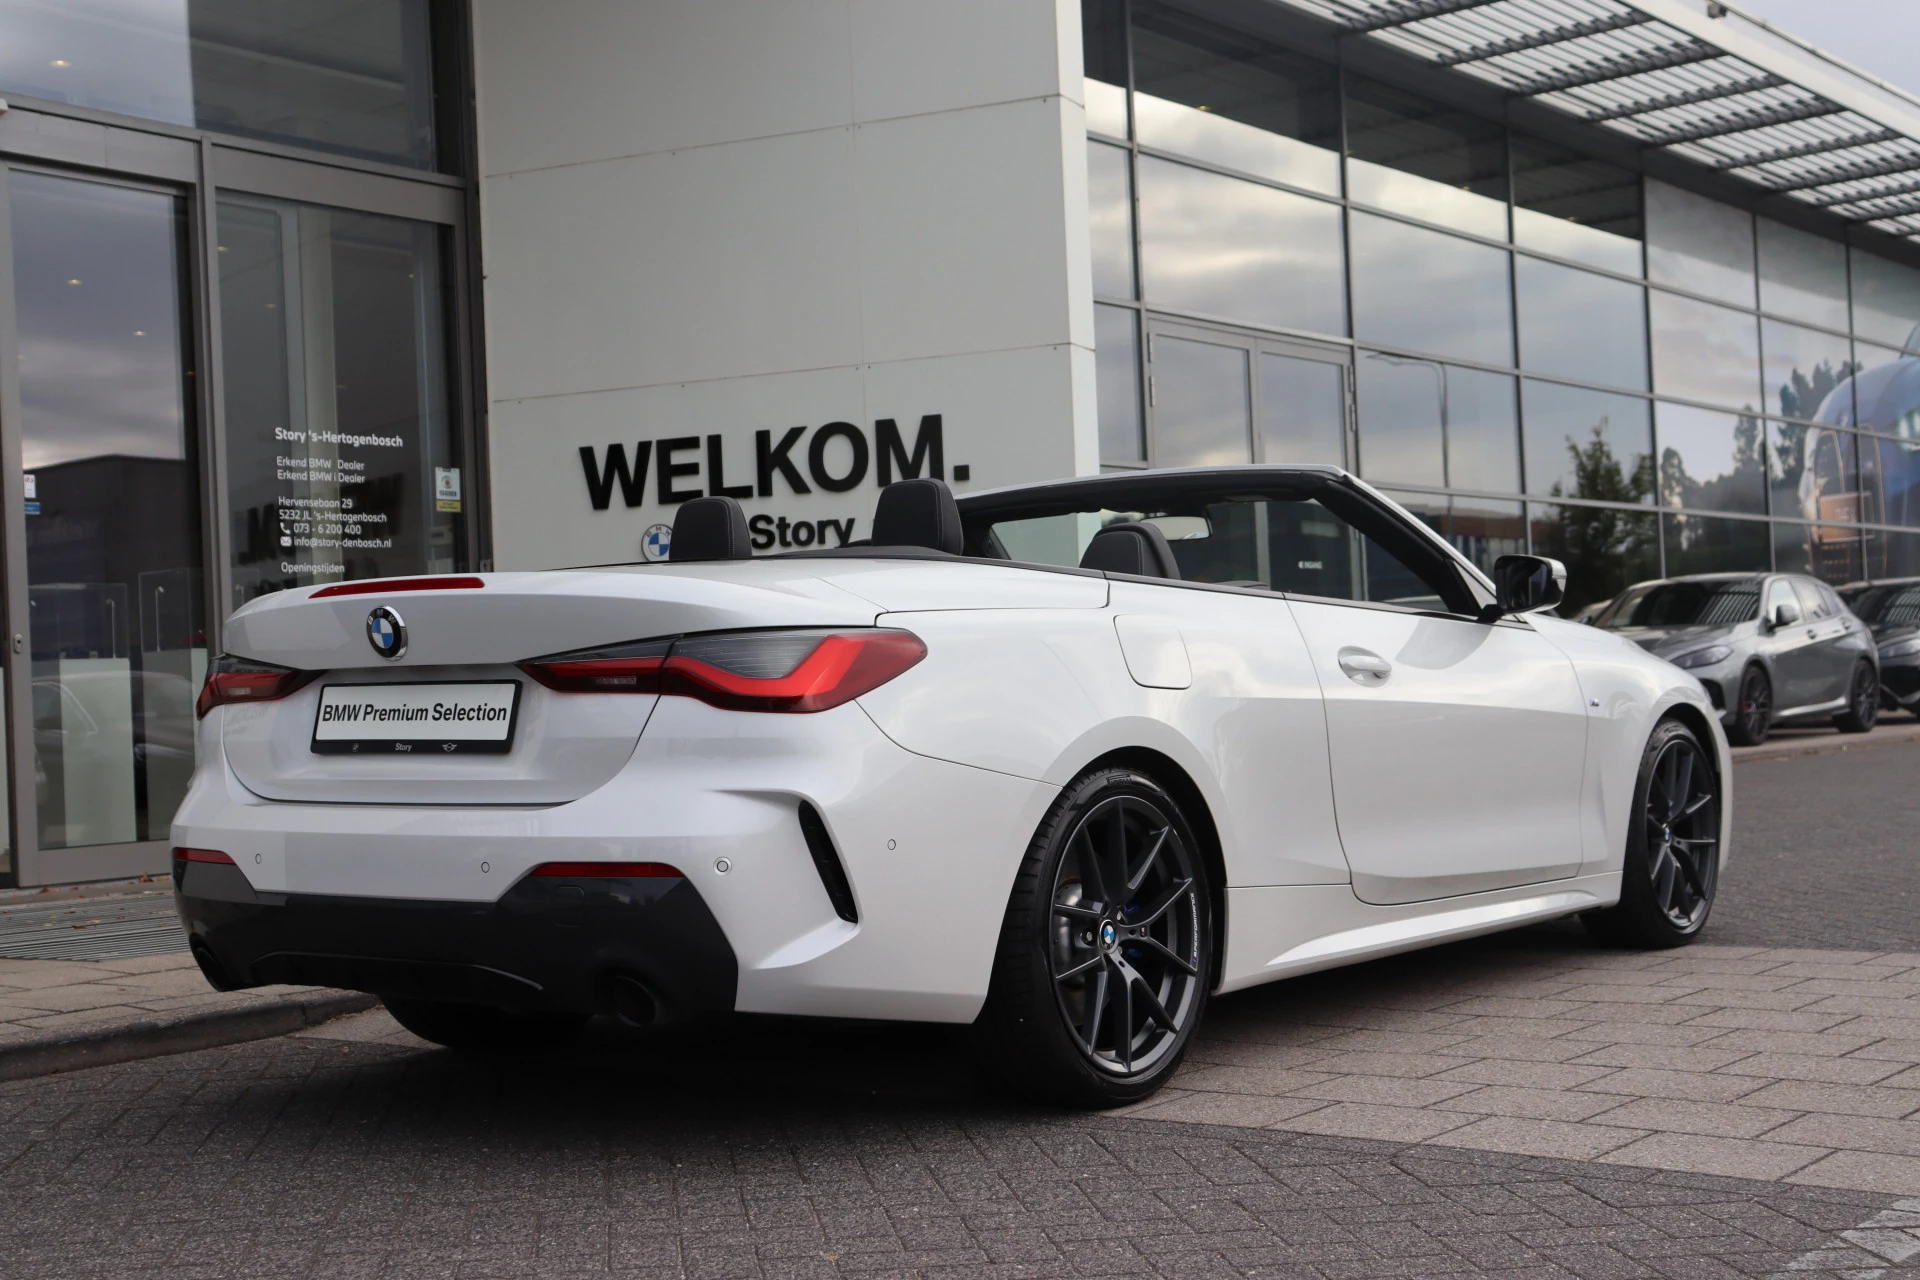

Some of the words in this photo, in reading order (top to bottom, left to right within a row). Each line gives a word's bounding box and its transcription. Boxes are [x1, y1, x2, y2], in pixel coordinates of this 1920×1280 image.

[275, 427, 306, 443] Story
[308, 430, 403, 447] 's-Hertogenbosch
[276, 456, 308, 468] Erkend
[309, 458, 332, 469] BMW
[337, 459, 365, 471] Dealer
[578, 413, 970, 510] WELKOM.
[277, 469, 308, 481] Erkend
[309, 471, 332, 482] BMW
[338, 472, 366, 484] Dealer
[278, 496, 340, 508] Hervensebaan
[341, 498, 353, 509] 29
[279, 510, 301, 521] 5232
[302, 511, 312, 521] JL
[313, 511, 388, 524] 's-Hertogenbosch
[293, 523, 310, 534] 073
[317, 524, 325, 534] 6
[325, 524, 342, 534] 200
[344, 524, 362, 535] 400
[749, 513, 856, 550] Story
[293, 536, 392, 549] info@story-denbosch.nl
[281, 561, 345, 574] Openingstijden
[322, 704, 362, 722] BMW
[363, 703, 429, 722] Premium
[432, 702, 507, 722] Selection
[395, 743, 412, 753] Story
